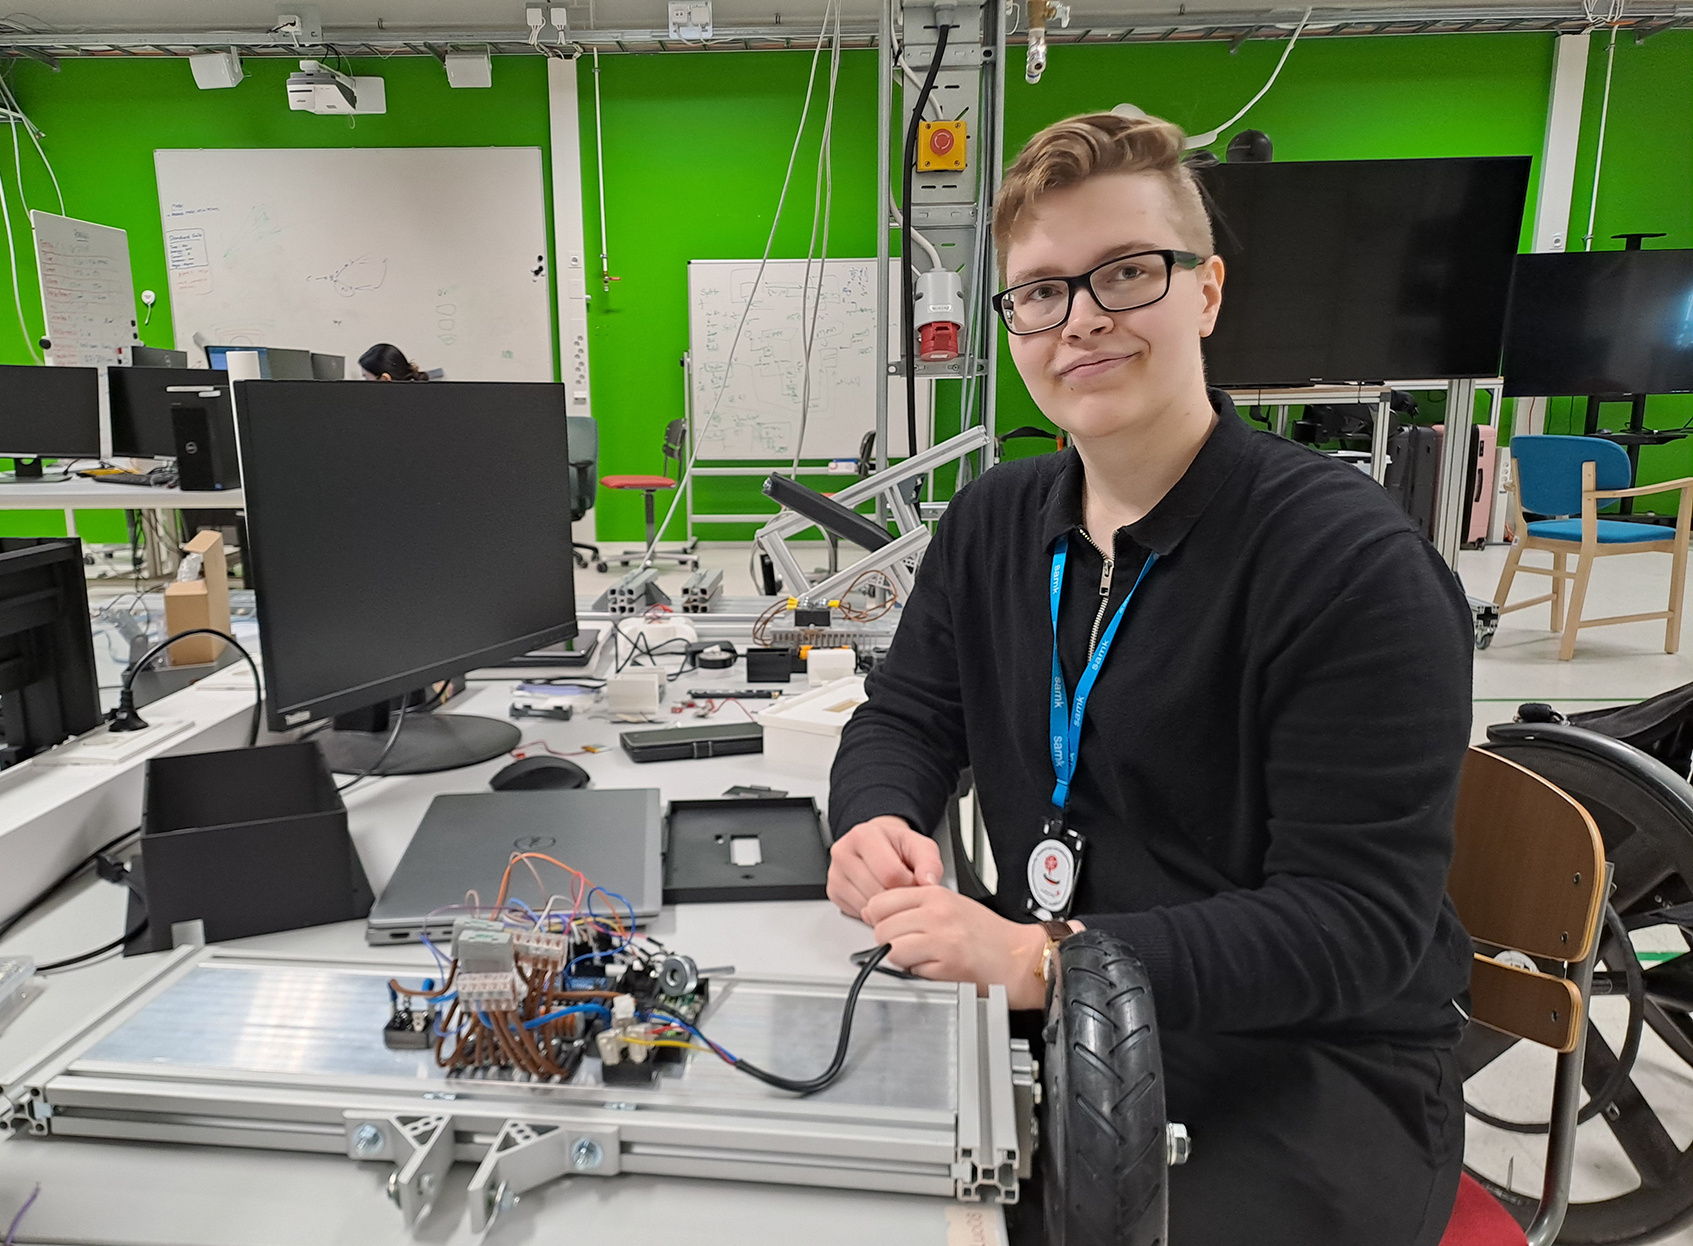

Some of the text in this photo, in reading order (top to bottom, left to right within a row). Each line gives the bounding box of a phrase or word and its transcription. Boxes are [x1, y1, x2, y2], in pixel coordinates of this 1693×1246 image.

[1052, 564, 1061, 595] samk
[1091, 640, 1109, 671] samk
[1054, 676, 1064, 709] samk
[1073, 696, 1085, 728] samk
[1053, 735, 1065, 768] samk
